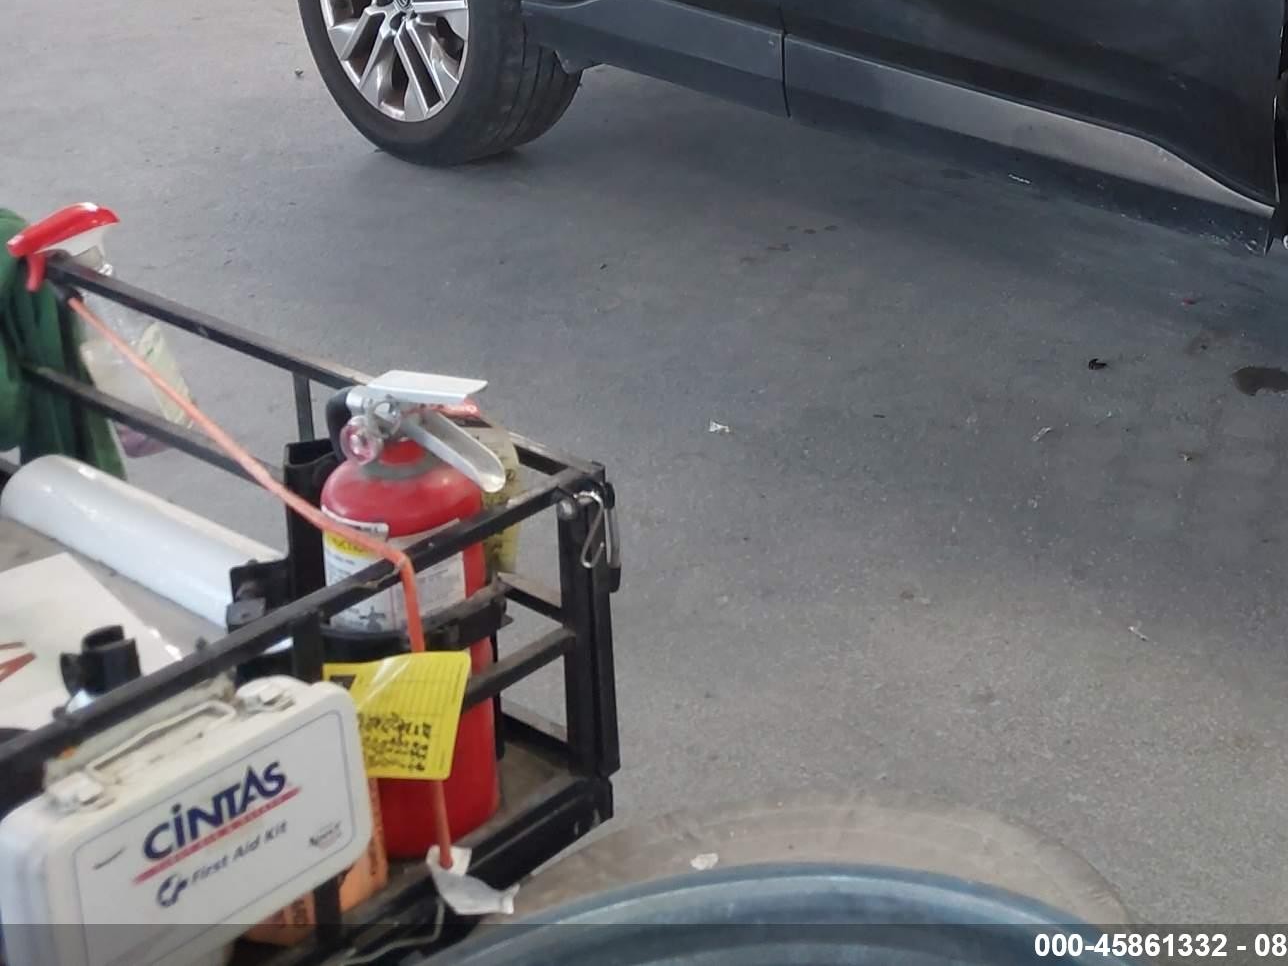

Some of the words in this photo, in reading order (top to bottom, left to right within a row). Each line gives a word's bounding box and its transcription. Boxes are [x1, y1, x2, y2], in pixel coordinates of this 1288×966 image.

[192, 855, 228, 885] First
[233, 833, 261, 862] Aid
[263, 819, 288, 845] Kit
